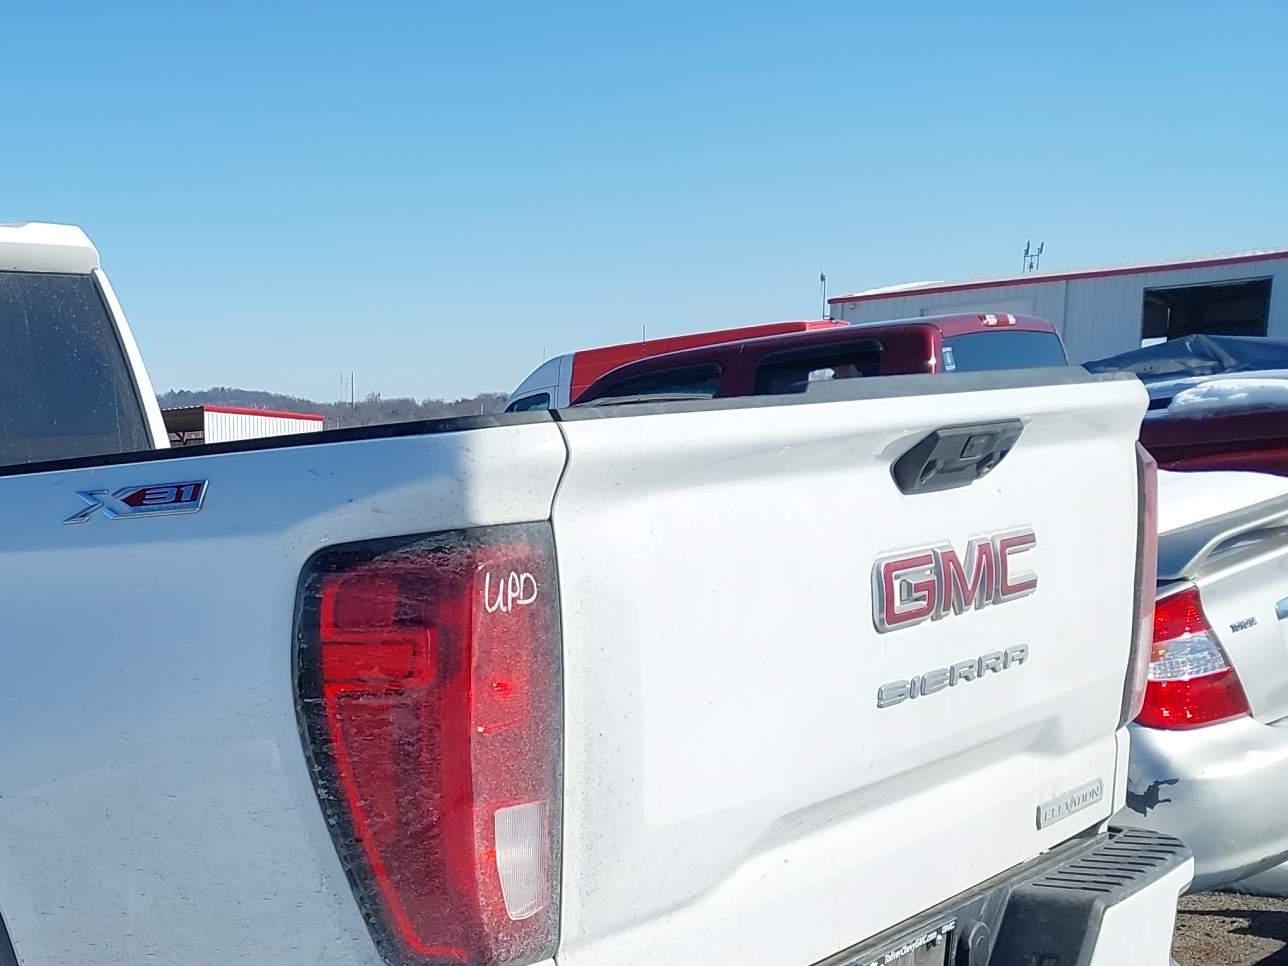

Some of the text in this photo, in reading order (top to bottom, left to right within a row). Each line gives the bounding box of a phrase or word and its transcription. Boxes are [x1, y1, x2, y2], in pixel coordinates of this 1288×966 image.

[63, 479, 209, 524] X31
[484, 570, 538, 613] UPD
[871, 524, 1039, 634] GMC
[877, 643, 1029, 709] SIERRA
[1042, 783, 1101, 822] ELEVATION
